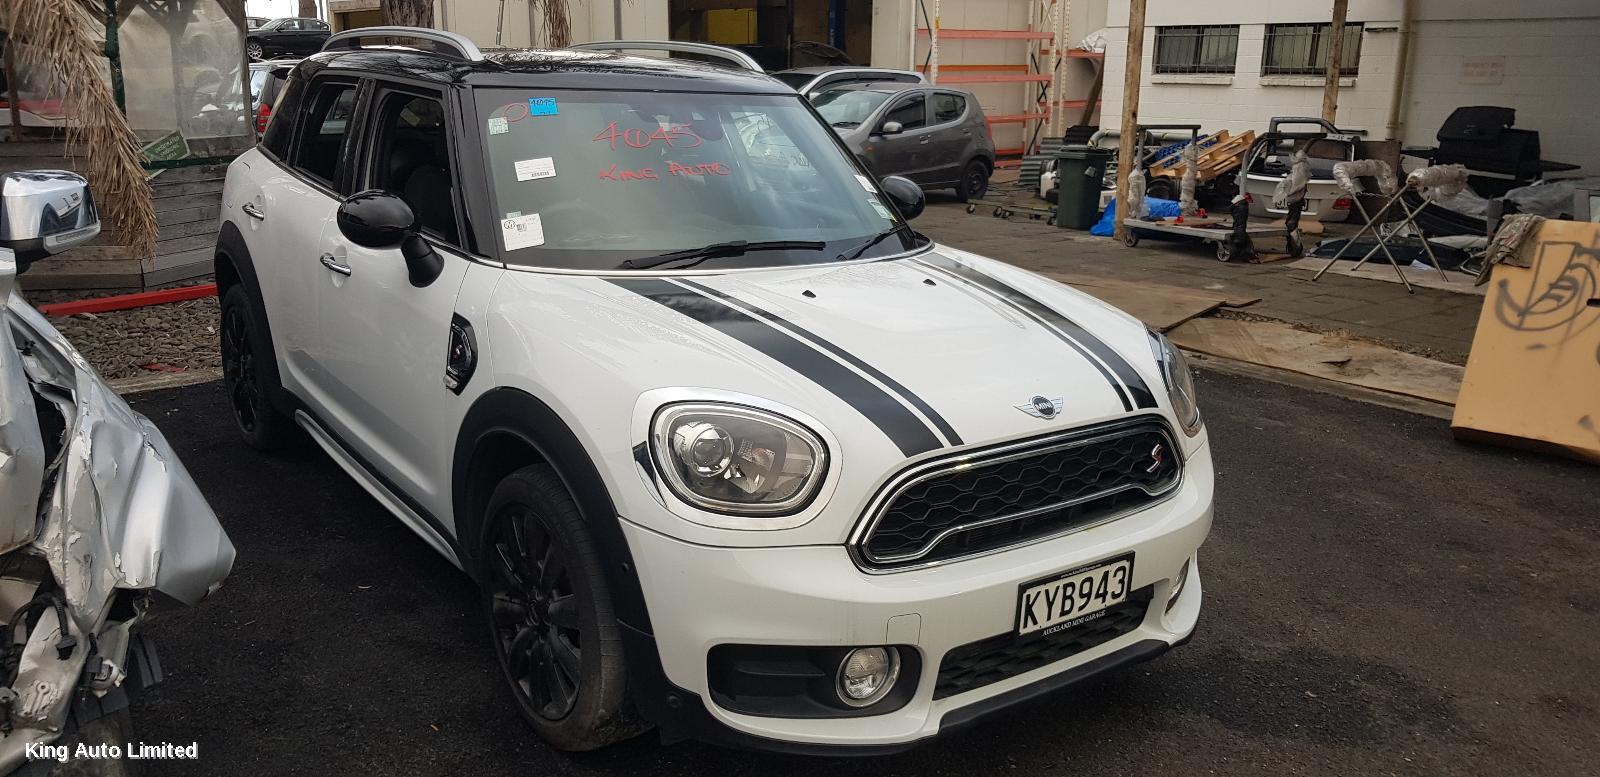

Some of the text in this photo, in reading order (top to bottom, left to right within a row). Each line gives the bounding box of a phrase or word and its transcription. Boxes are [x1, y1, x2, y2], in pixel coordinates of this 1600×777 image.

[592, 120, 702, 151] 4045
[599, 161, 731, 182] KING AUTO
[1034, 401, 1052, 411] MINI
[1022, 565, 1127, 630] KYB943
[1042, 610, 1107, 637] AUCKLAND MINI GARAGE
